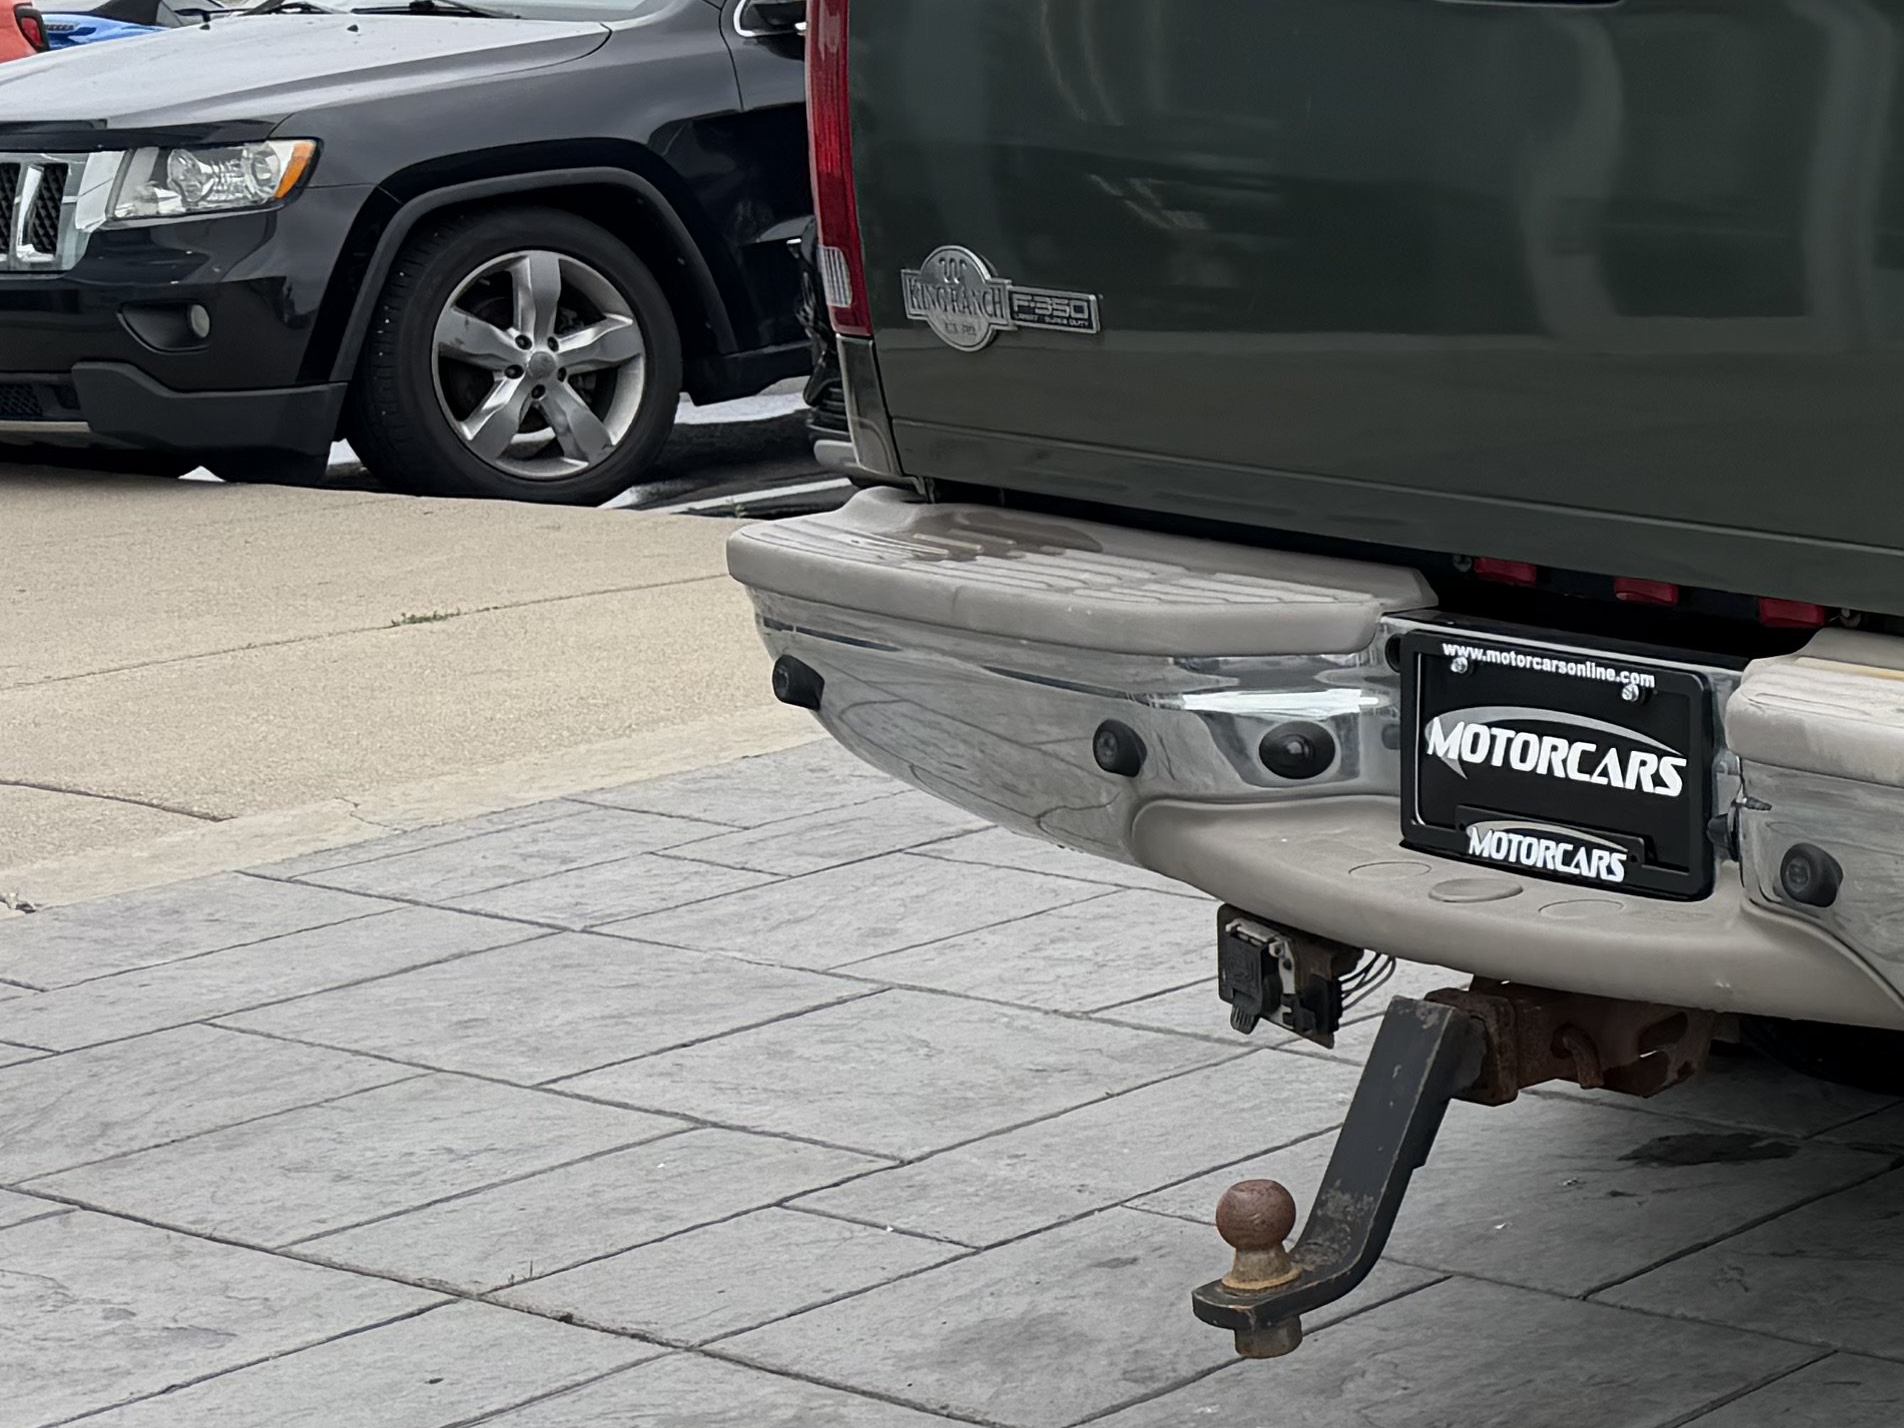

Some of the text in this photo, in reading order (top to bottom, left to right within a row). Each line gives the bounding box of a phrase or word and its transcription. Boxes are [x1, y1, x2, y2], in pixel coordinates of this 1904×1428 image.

[1442, 642, 1655, 689] www.motorcarsonline.com
[1427, 716, 1687, 797] MOTORCARS
[1468, 826, 1627, 883] MOTORCARS
